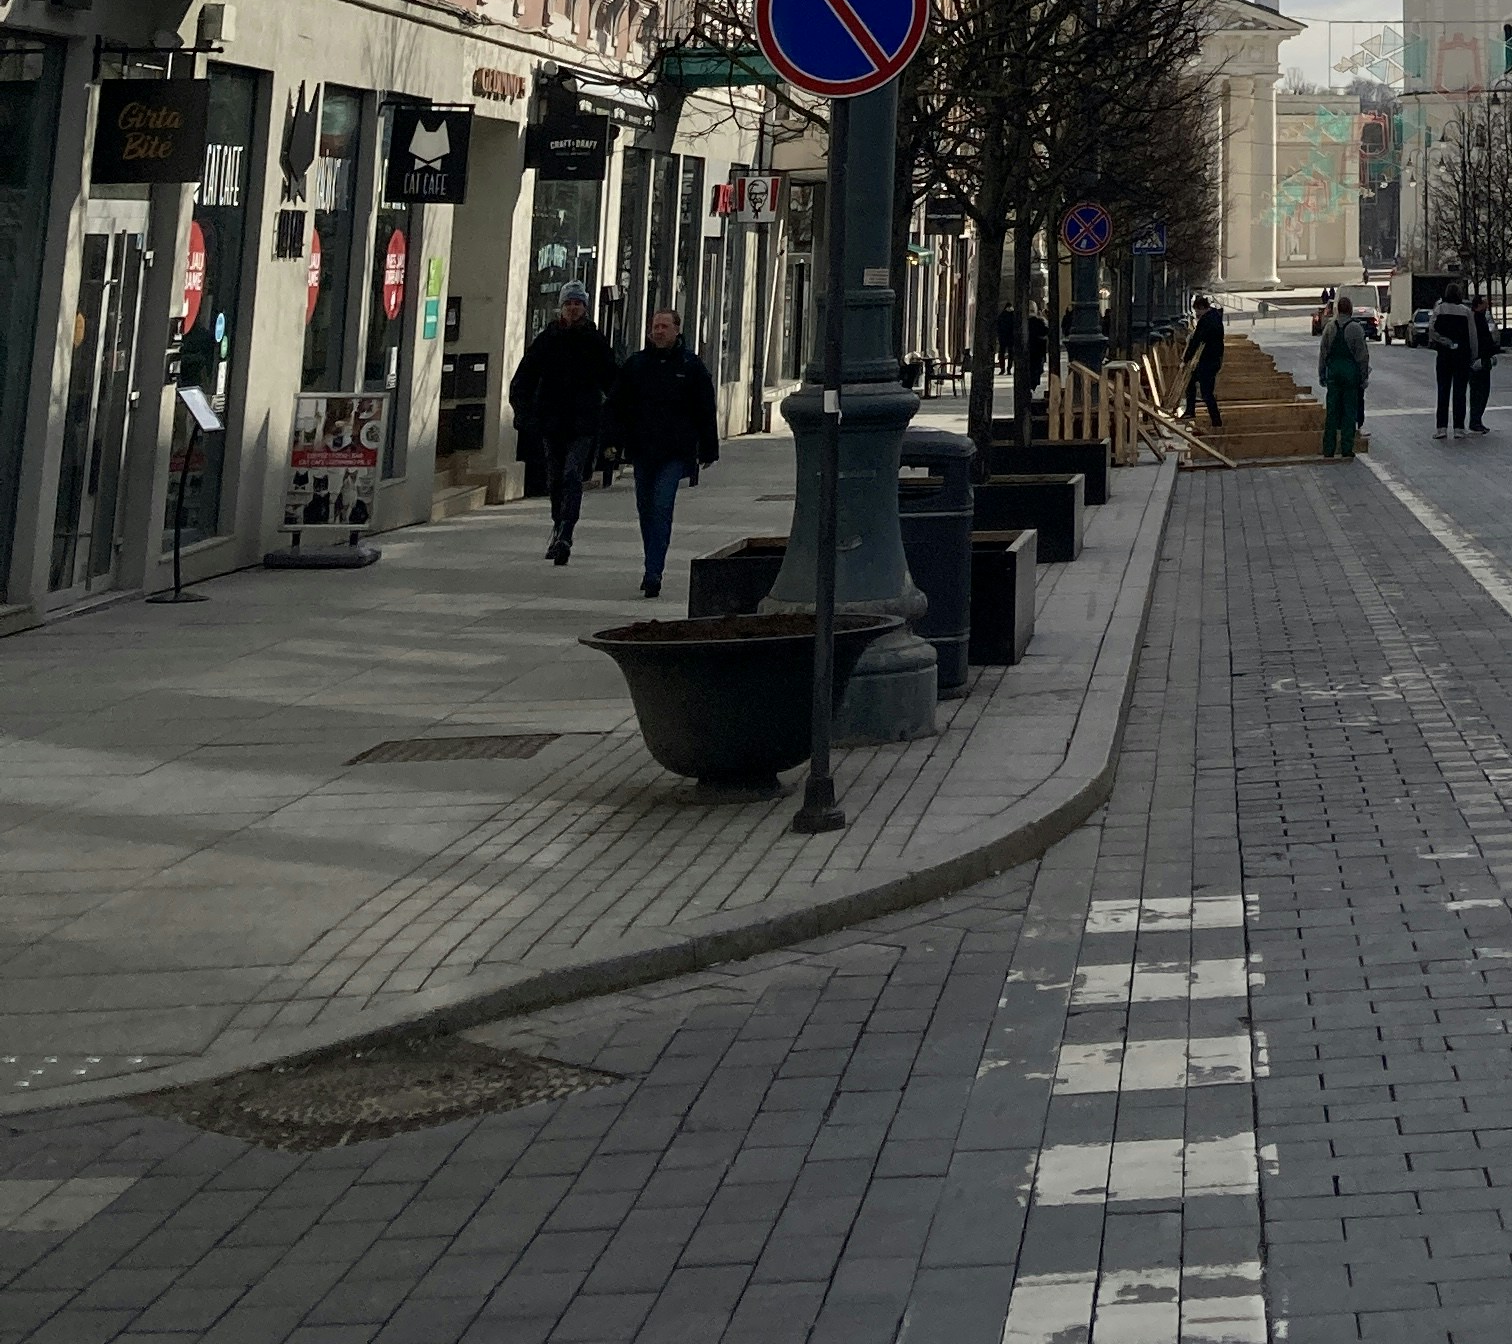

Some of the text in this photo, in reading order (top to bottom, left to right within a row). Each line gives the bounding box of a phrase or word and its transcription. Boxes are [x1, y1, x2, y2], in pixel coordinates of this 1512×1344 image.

[118, 102, 181, 130] Girta
[203, 144, 222, 206] CAT
[219, 144, 244, 207] CAFE
[403, 173, 449, 197] CAT CAFE
